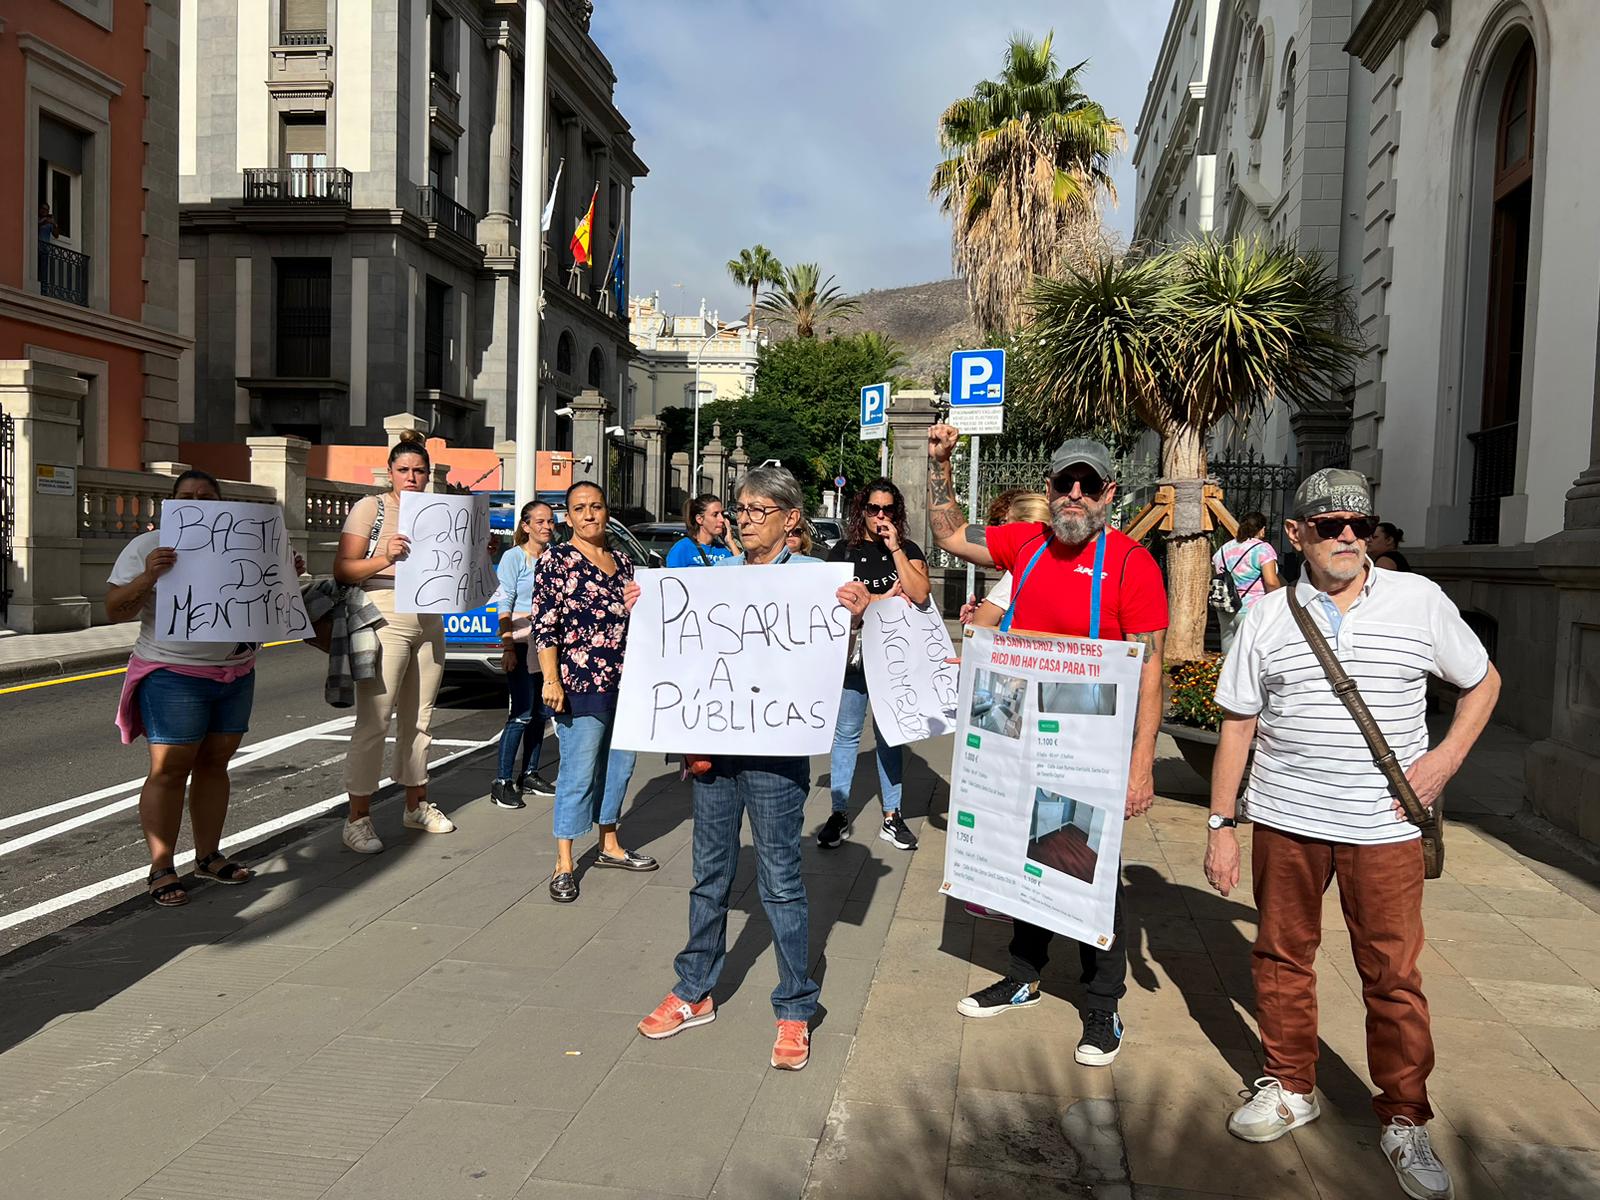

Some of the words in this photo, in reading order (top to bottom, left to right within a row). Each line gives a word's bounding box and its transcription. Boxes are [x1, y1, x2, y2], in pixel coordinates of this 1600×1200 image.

[961, 357, 993, 399] P
[865, 390, 880, 422] P
[172, 505, 281, 555] BASTA
[219, 558, 283, 593] DE
[853, 569, 898, 588] OPEFU
[660, 576, 847, 657] PASARLAS
[1006, 635, 1032, 650] SANTA
[1032, 639, 1053, 652] CRUZ
[1067, 642, 1079, 655] NO
[1080, 643, 1103, 658] ERES
[709, 657, 734, 692] A
[991, 651, 1009, 665] RICO
[1010, 653, 1021, 667] NO
[1022, 655, 1038, 669] HAY
[1039, 657, 1061, 672] CASA
[1062, 660, 1086, 676] PARA
[1088, 663, 1101, 677] TI!
[1038, 738, 1053, 746] 1.100
